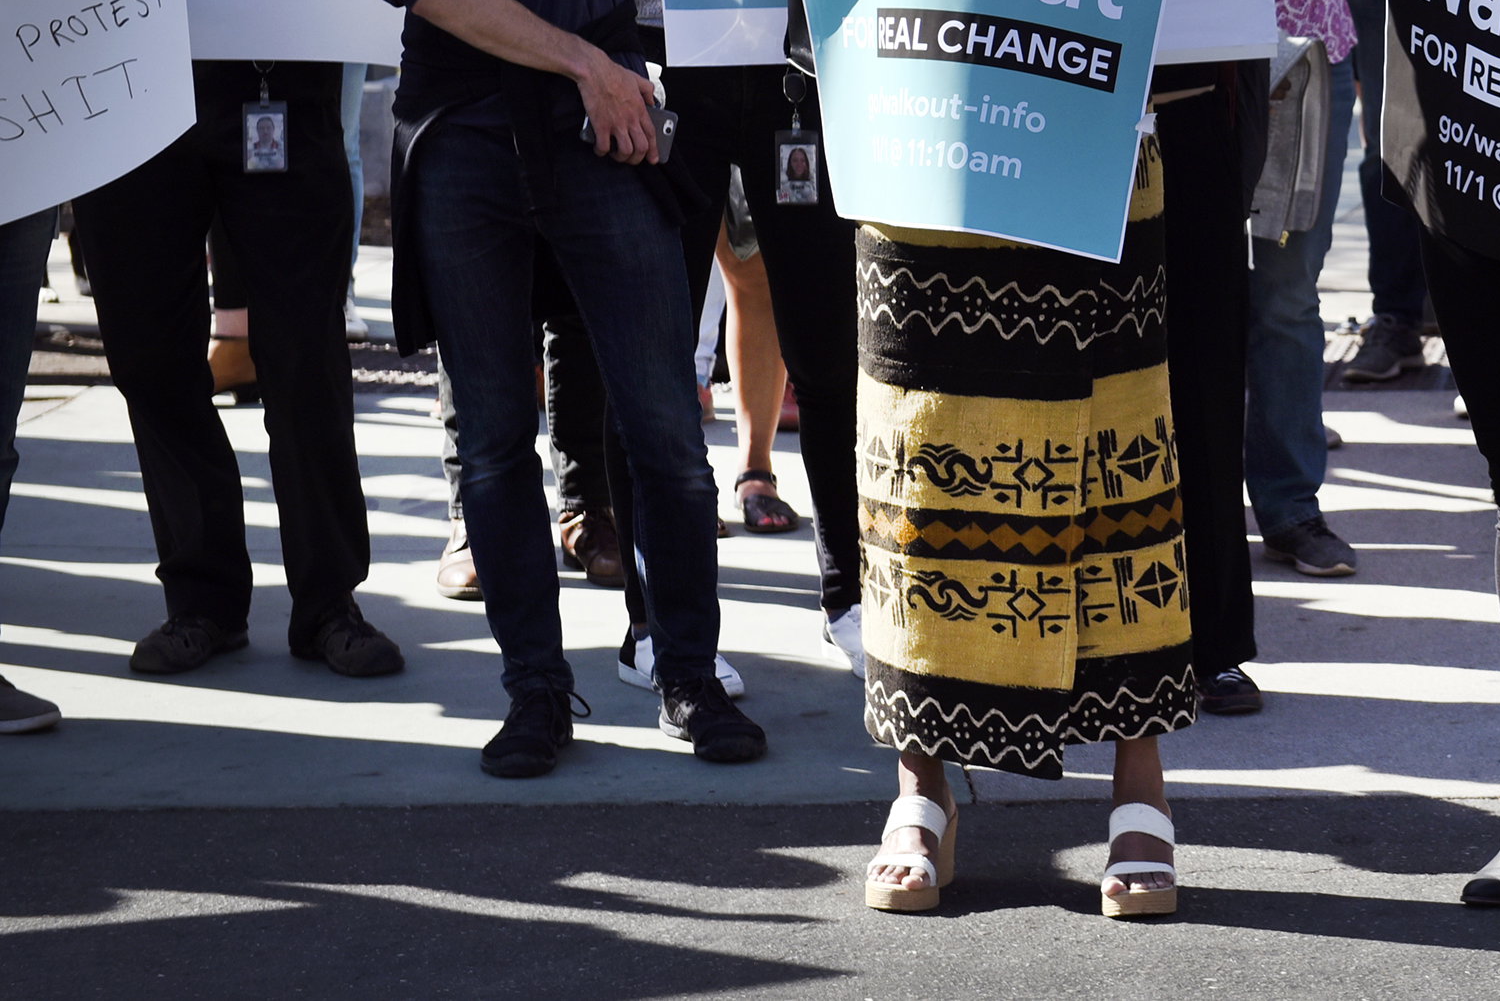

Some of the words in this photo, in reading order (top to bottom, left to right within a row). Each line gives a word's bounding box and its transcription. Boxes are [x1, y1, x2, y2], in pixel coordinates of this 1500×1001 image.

[841, 16, 877, 49] FOR
[877, 16, 928, 51] REAL
[936, 20, 1113, 82] CHANGE
[1410, 24, 1458, 78] FOR
[907, 138, 1023, 179] 11:10am
[1444, 160, 1485, 201] 11/1
